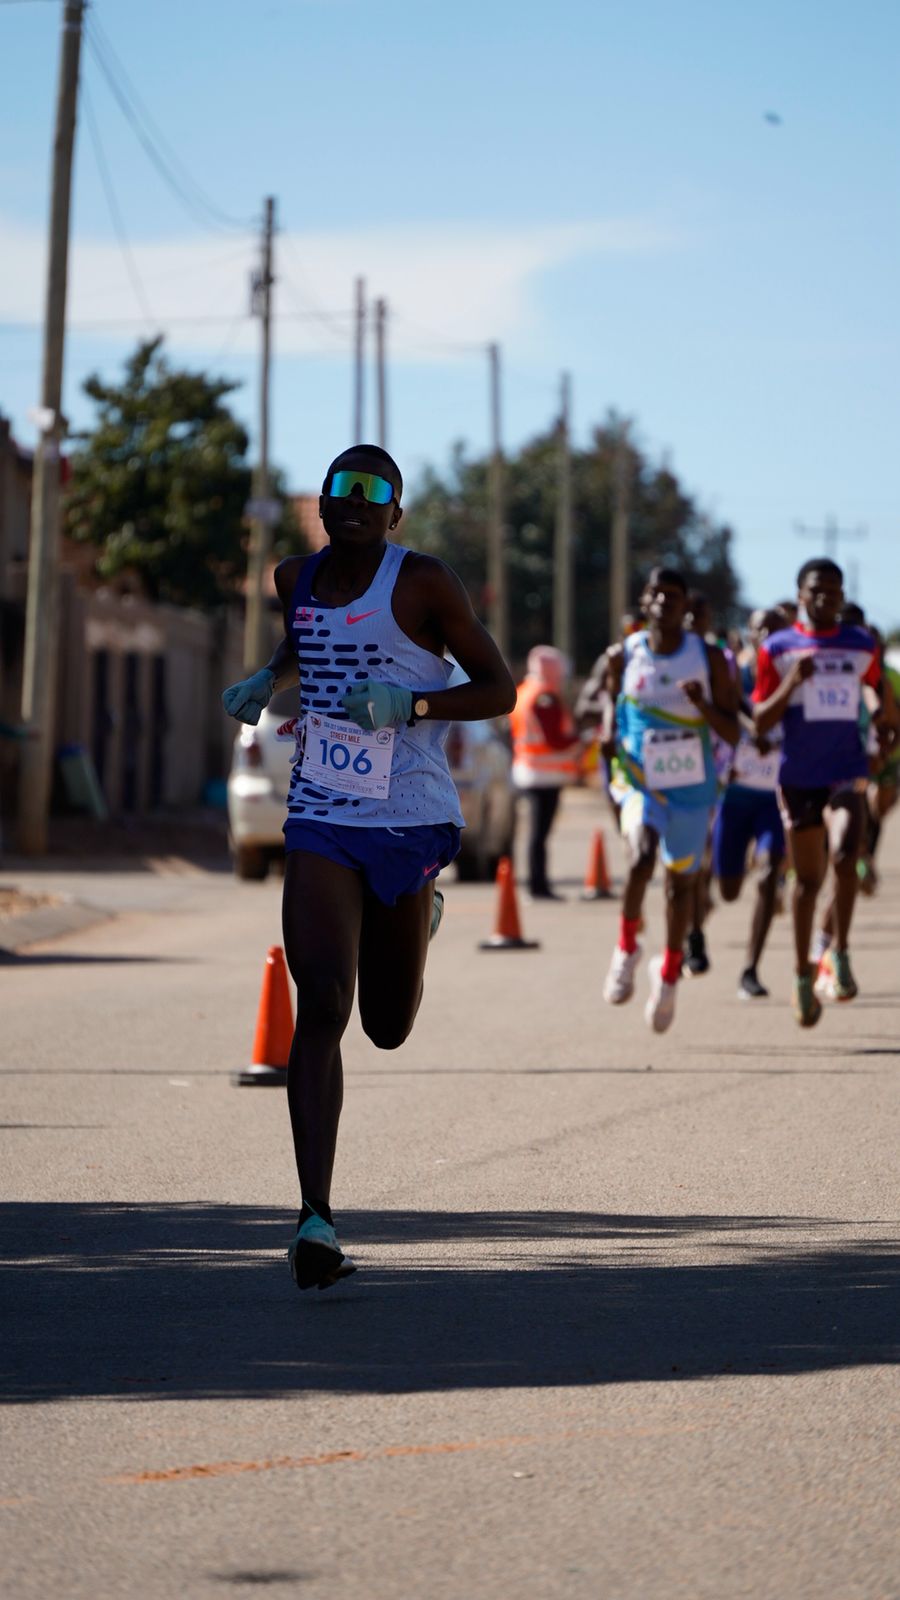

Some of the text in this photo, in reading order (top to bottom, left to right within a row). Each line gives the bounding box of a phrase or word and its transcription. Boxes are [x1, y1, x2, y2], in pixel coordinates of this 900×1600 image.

[818, 688, 849, 706] 182
[330, 731, 361, 744] STREET MILE
[320, 738, 372, 775] 106
